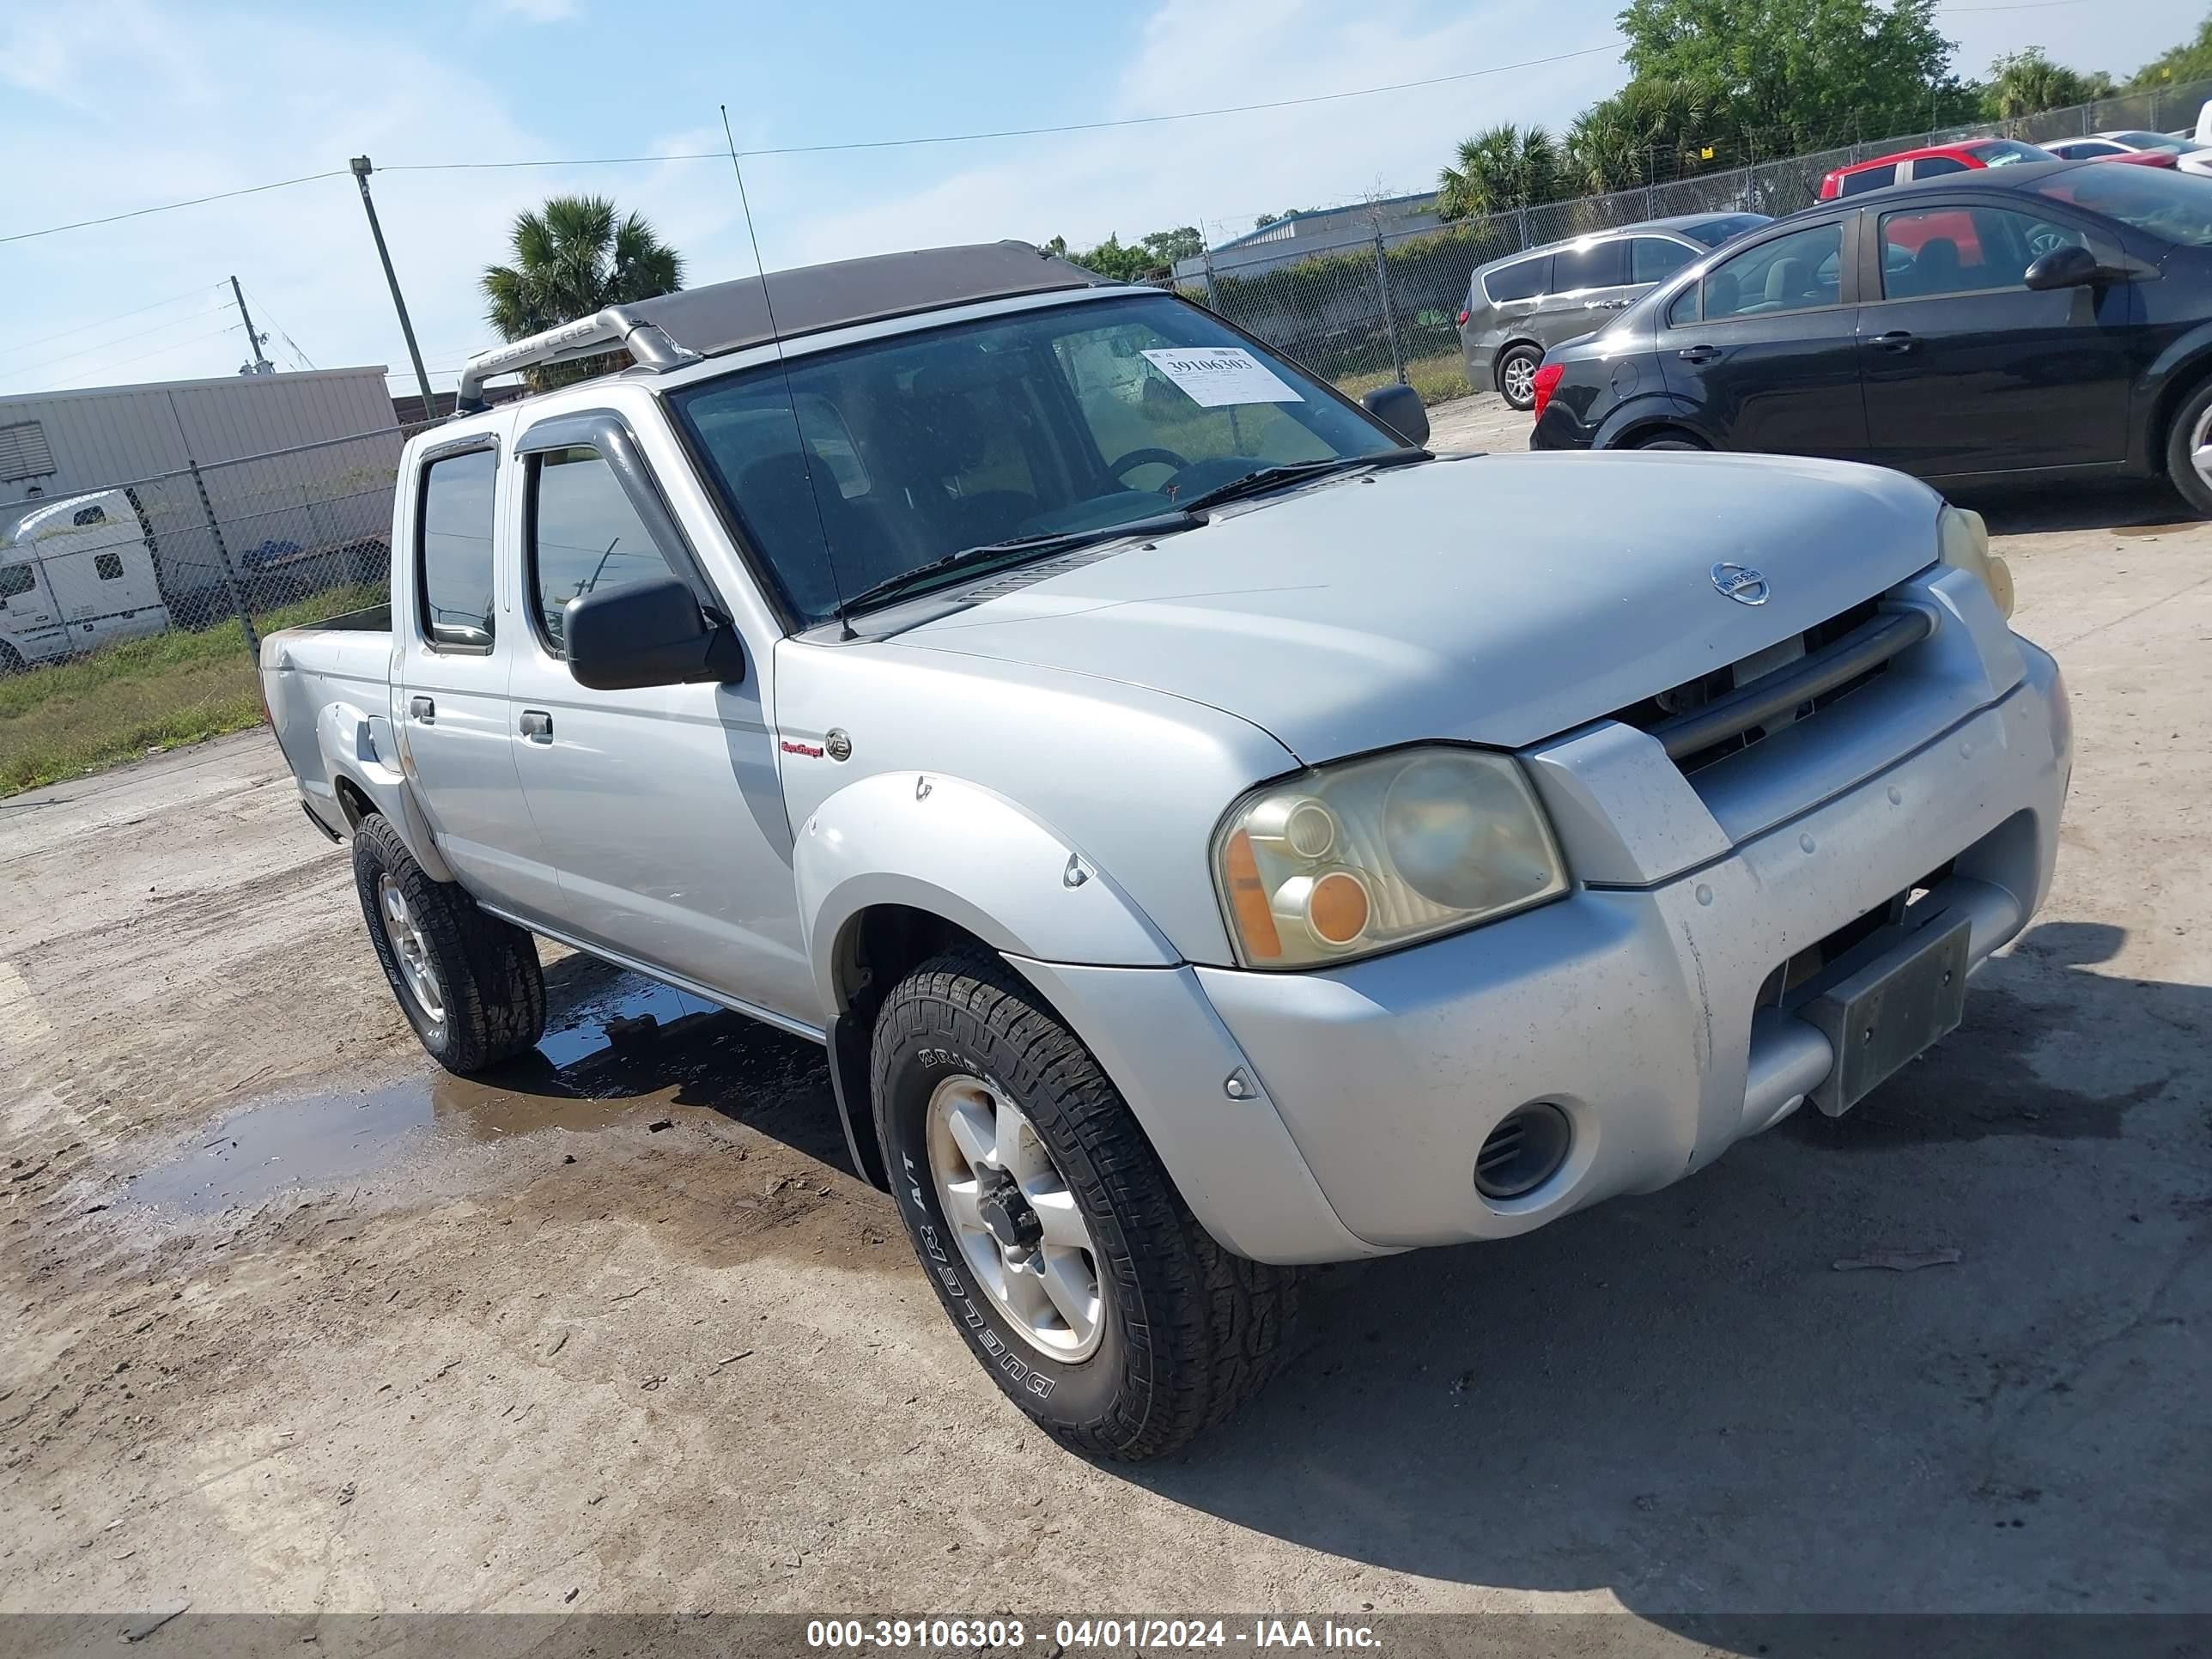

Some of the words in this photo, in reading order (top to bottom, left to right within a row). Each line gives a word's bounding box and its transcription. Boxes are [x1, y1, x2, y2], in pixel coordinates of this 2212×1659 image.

[1167, 359, 1253, 373] 39106303
[1723, 570, 1760, 589] NISSAN
[901, 1150, 927, 1212] A/T
[919, 1224, 1058, 1400] DUELER
